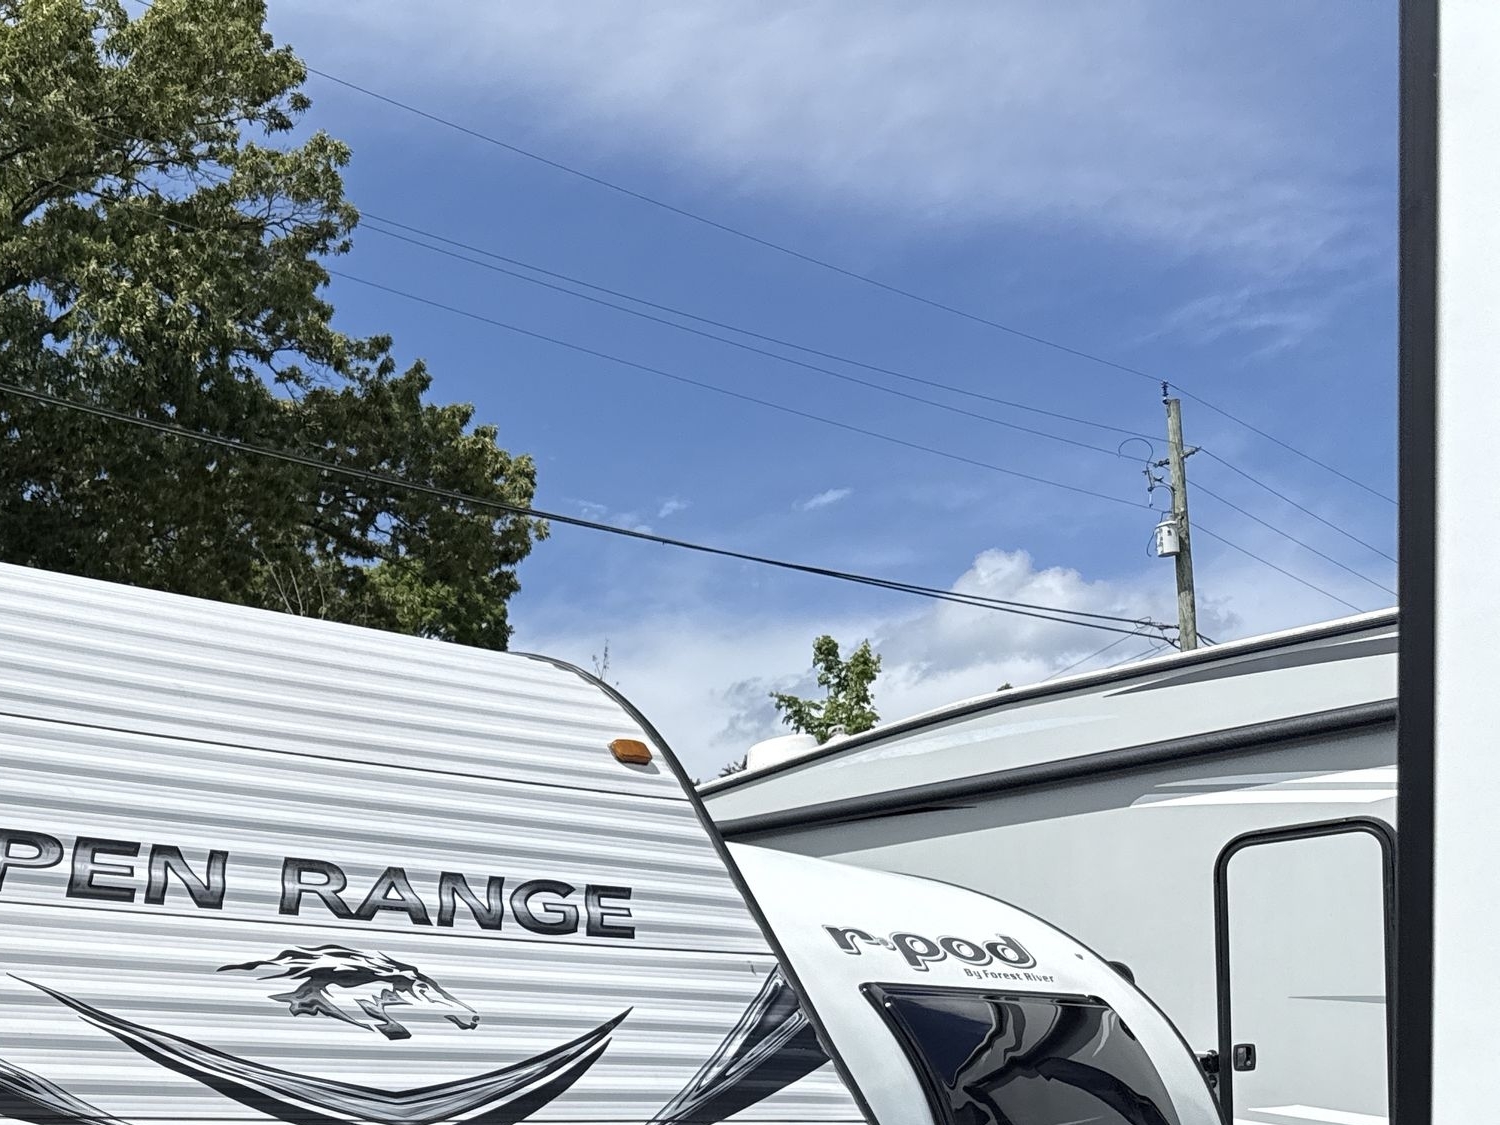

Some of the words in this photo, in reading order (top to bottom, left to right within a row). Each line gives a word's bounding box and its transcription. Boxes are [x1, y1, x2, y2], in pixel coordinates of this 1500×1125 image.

[278, 855, 637, 940] RANGE
[963, 968, 981, 980] By
[983, 969, 1023, 981] Forest
[1025, 972, 1055, 983] River
